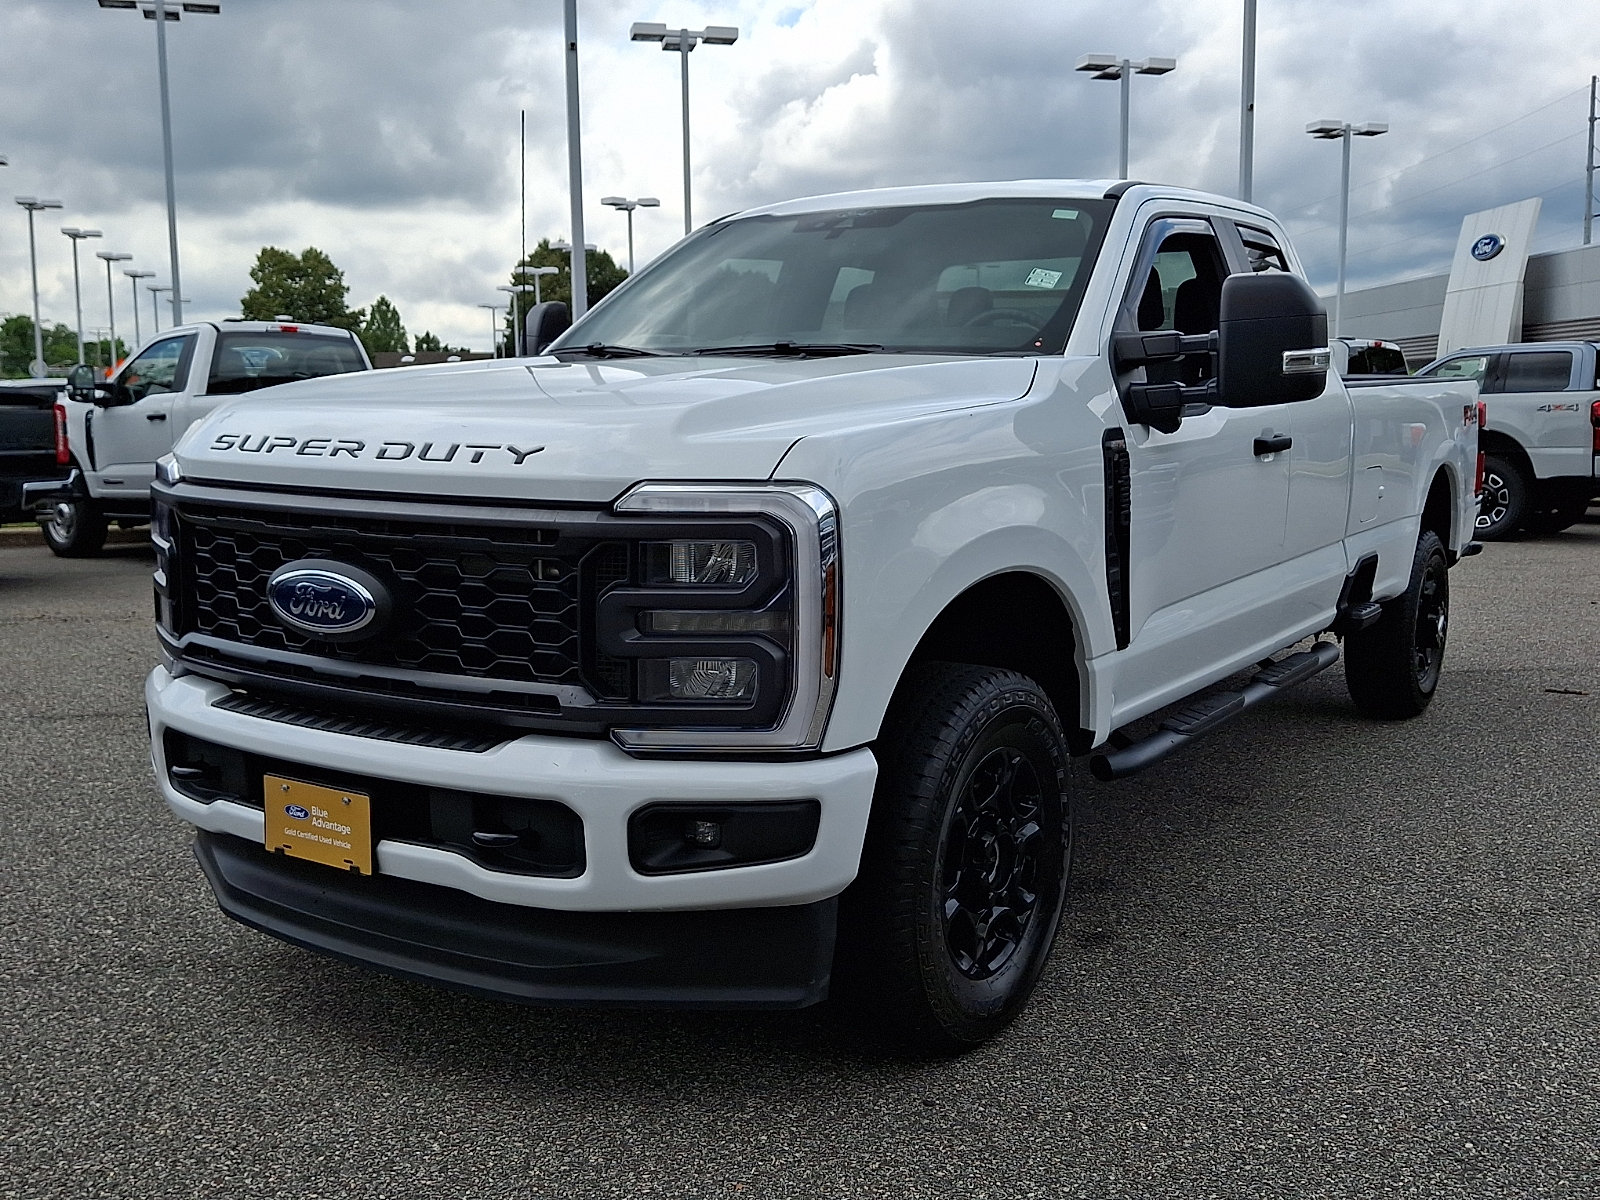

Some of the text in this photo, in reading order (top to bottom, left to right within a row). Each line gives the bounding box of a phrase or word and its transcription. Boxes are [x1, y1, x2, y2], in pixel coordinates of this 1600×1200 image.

[210, 434, 545, 465] SUPER DUTY
[289, 581, 346, 620] Ford
[288, 805, 305, 817] Ford
[311, 806, 328, 818] Blue
[311, 817, 351, 834] Advantage
[284, 827, 352, 849] Gold Certified Used Vehicle
